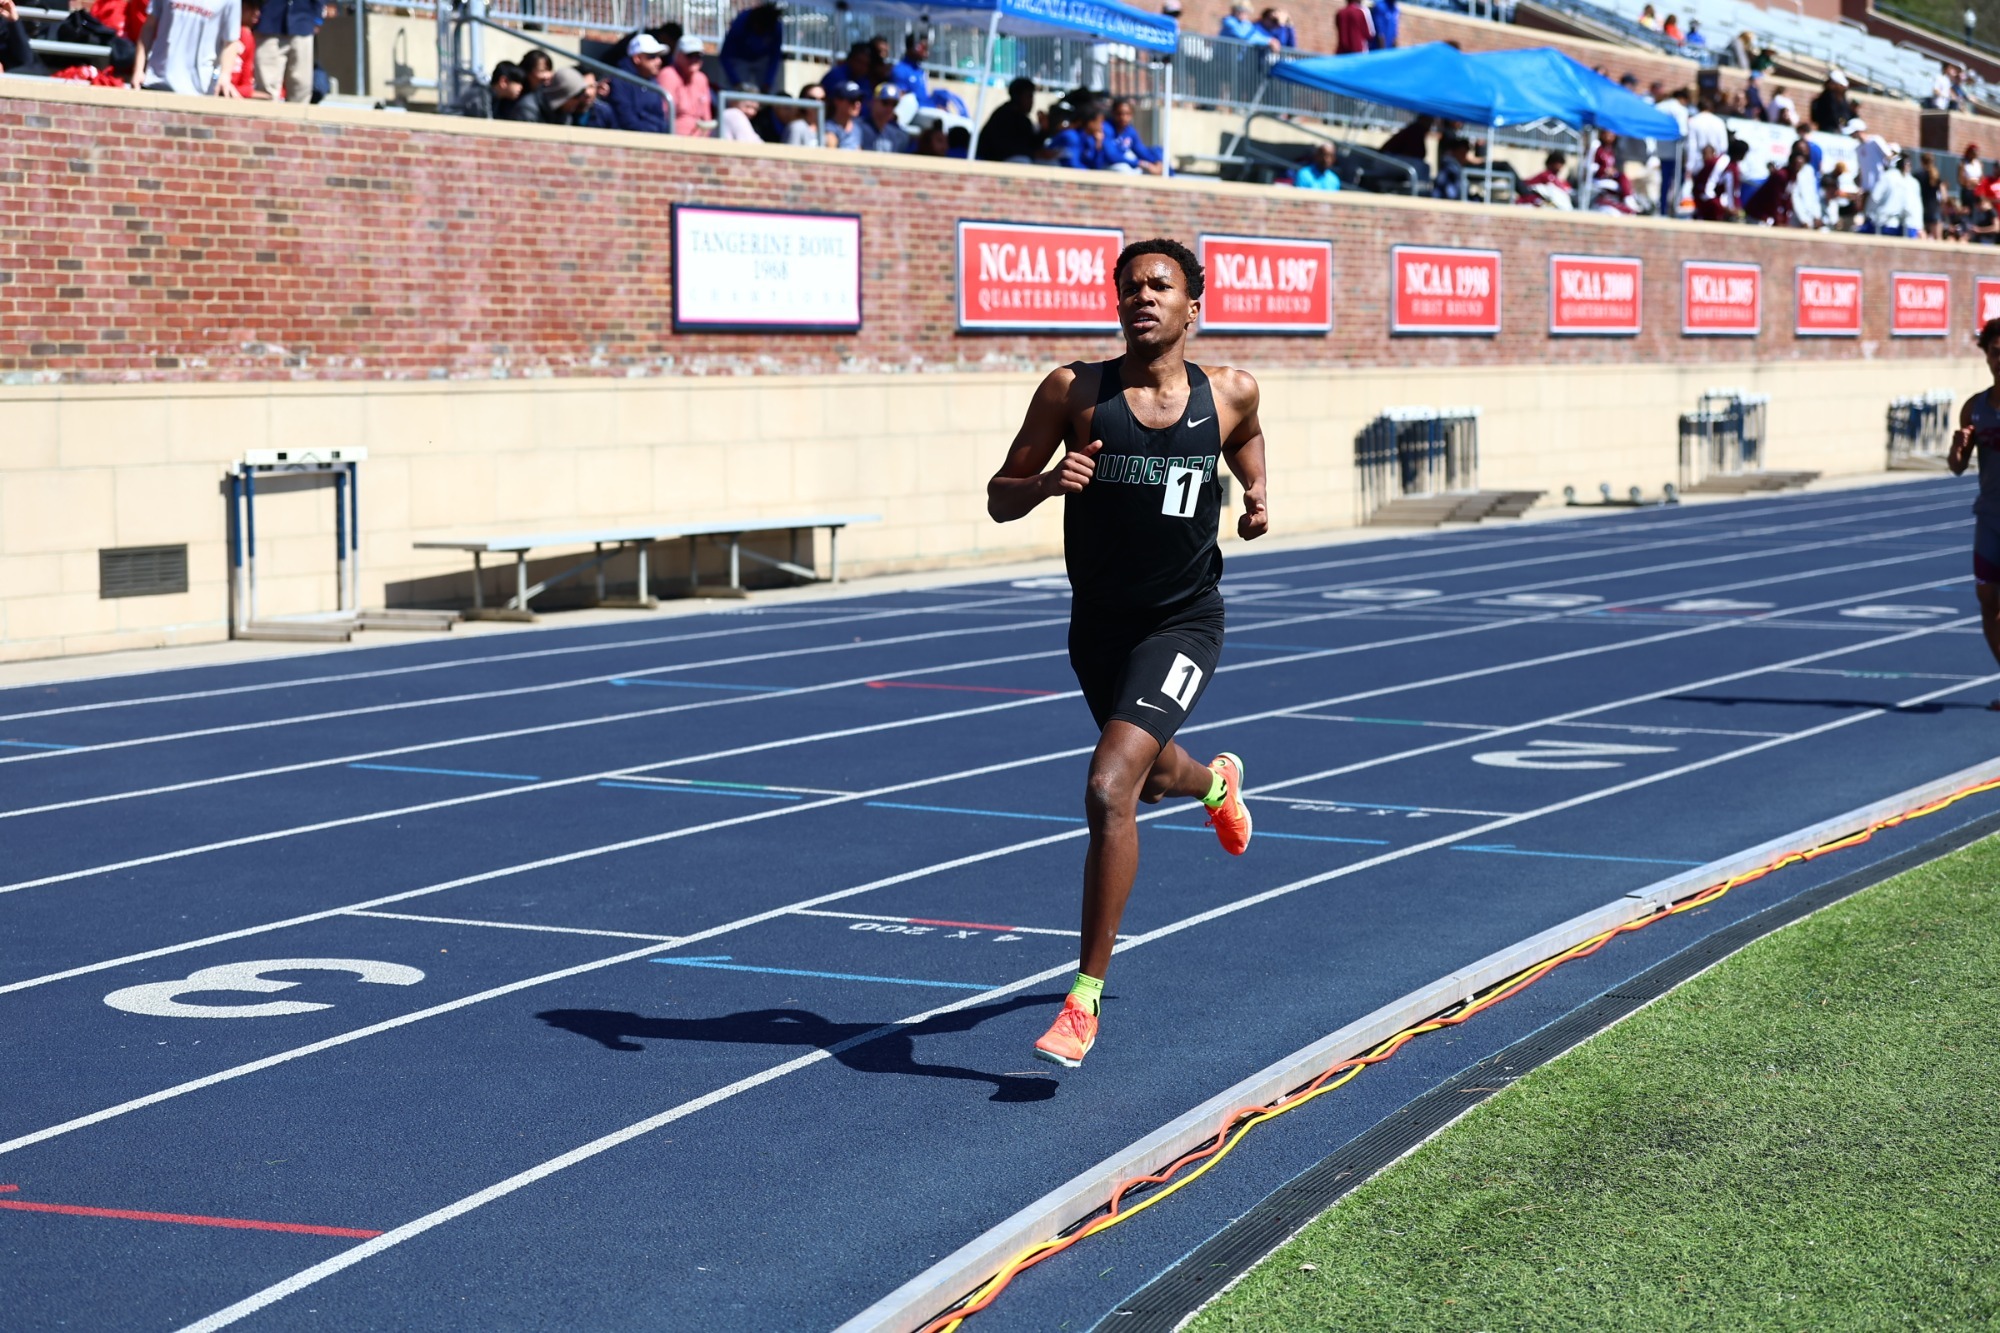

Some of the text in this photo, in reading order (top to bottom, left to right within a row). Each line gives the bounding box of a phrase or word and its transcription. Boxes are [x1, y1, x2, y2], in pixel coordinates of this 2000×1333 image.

[691, 230, 847, 258] TANGERINE BOWL
[978, 243, 1105, 286] NCAA 1984
[1214, 253, 1318, 293] NCAA 1987
[1405, 262, 1454, 296] NCAA
[978, 288, 1107, 311] QUARTERFINALS
[1561, 269, 1601, 301] NCAA
[1691, 274, 1727, 304] NCAA
[1801, 279, 1832, 306] NCAA
[1223, 294, 1311, 314] FIRST ROUND
[1176, 472, 1193, 514] 1
[1176, 665, 1195, 702] 1
[849, 922, 937, 936] 200
[103, 958, 425, 1019] 3
